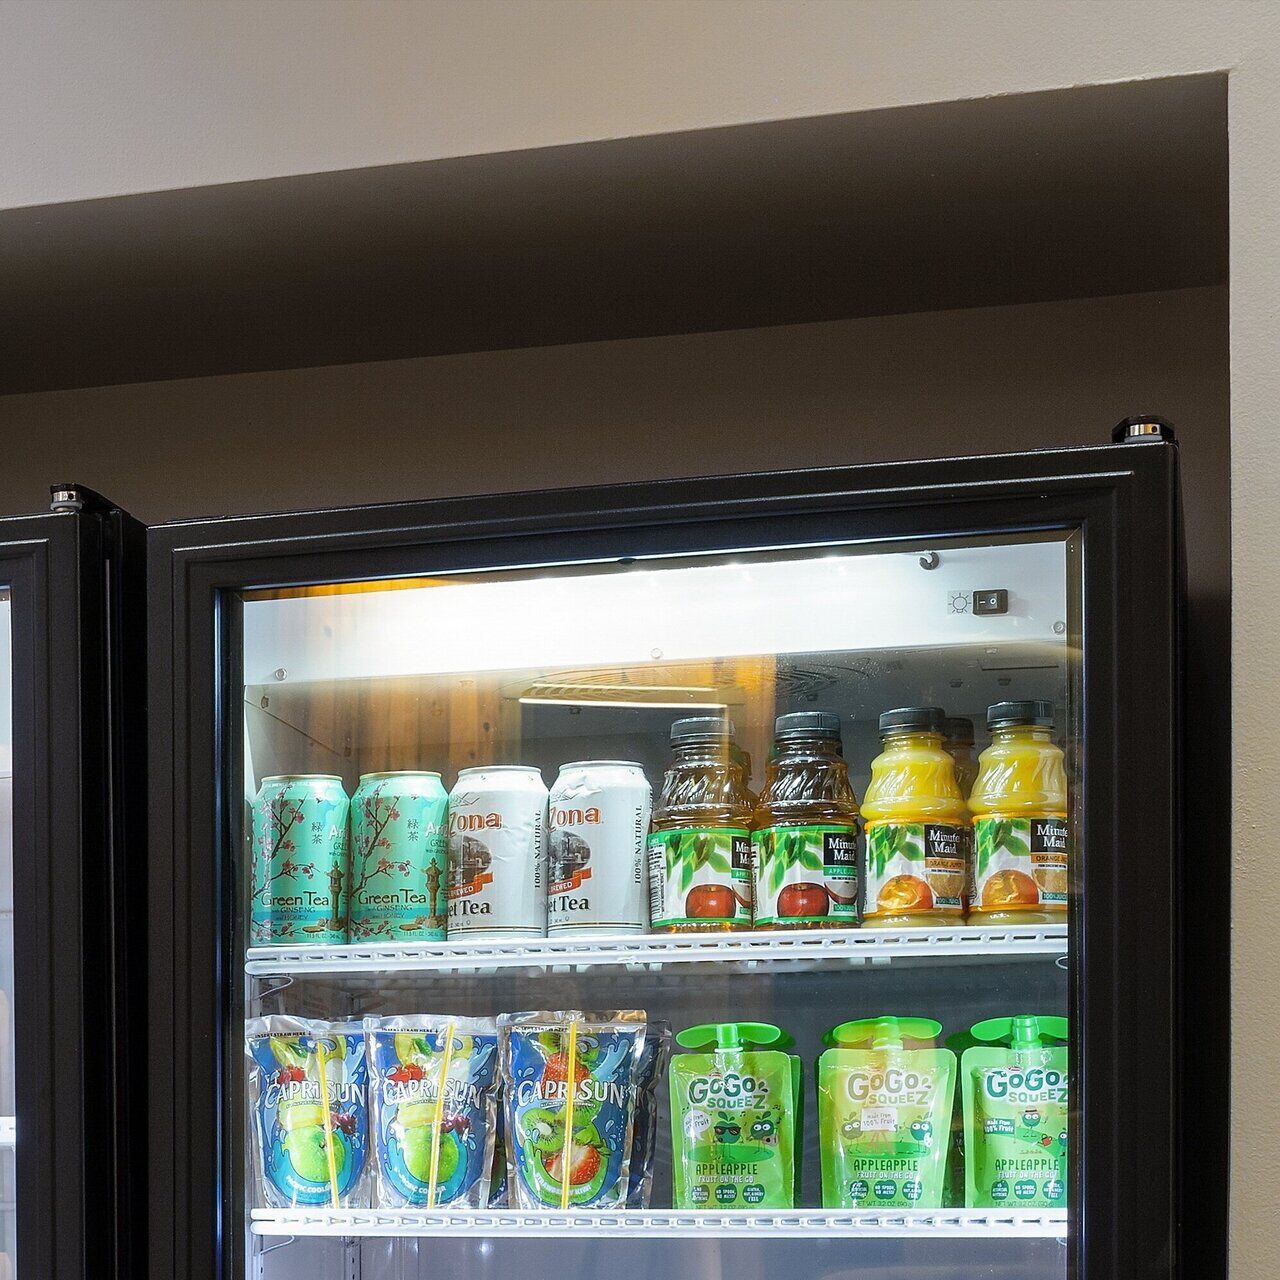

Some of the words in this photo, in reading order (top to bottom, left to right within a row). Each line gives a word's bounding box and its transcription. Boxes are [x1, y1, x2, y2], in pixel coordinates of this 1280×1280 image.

[534, 810, 542, 859] NATURAL
[928, 829, 960, 843] Minute
[1043, 836, 1066, 848] Maid
[934, 842, 957, 854] Maid
[634, 858, 642, 885] 100%
[261, 892, 303, 906] Green
[304, 891, 329, 906] Tea
[358, 890, 399, 905] Green
[399, 888, 427, 904] Tea
[558, 895, 590, 911] Tea
[460, 899, 491, 916] Tea
[688, 1073, 756, 1104] GoGo
[847, 1069, 919, 1101] GoGo
[986, 1069, 1061, 1098] GoGo
[707, 1094, 766, 1110] SQUEEZ
[868, 1091, 929, 1105] SQUEEZ
[696, 1163, 758, 1175] APPLEAPPLE
[853, 1159, 919, 1172] APPLEAPPLE
[994, 1159, 1060, 1171] APPLEAPPLE
